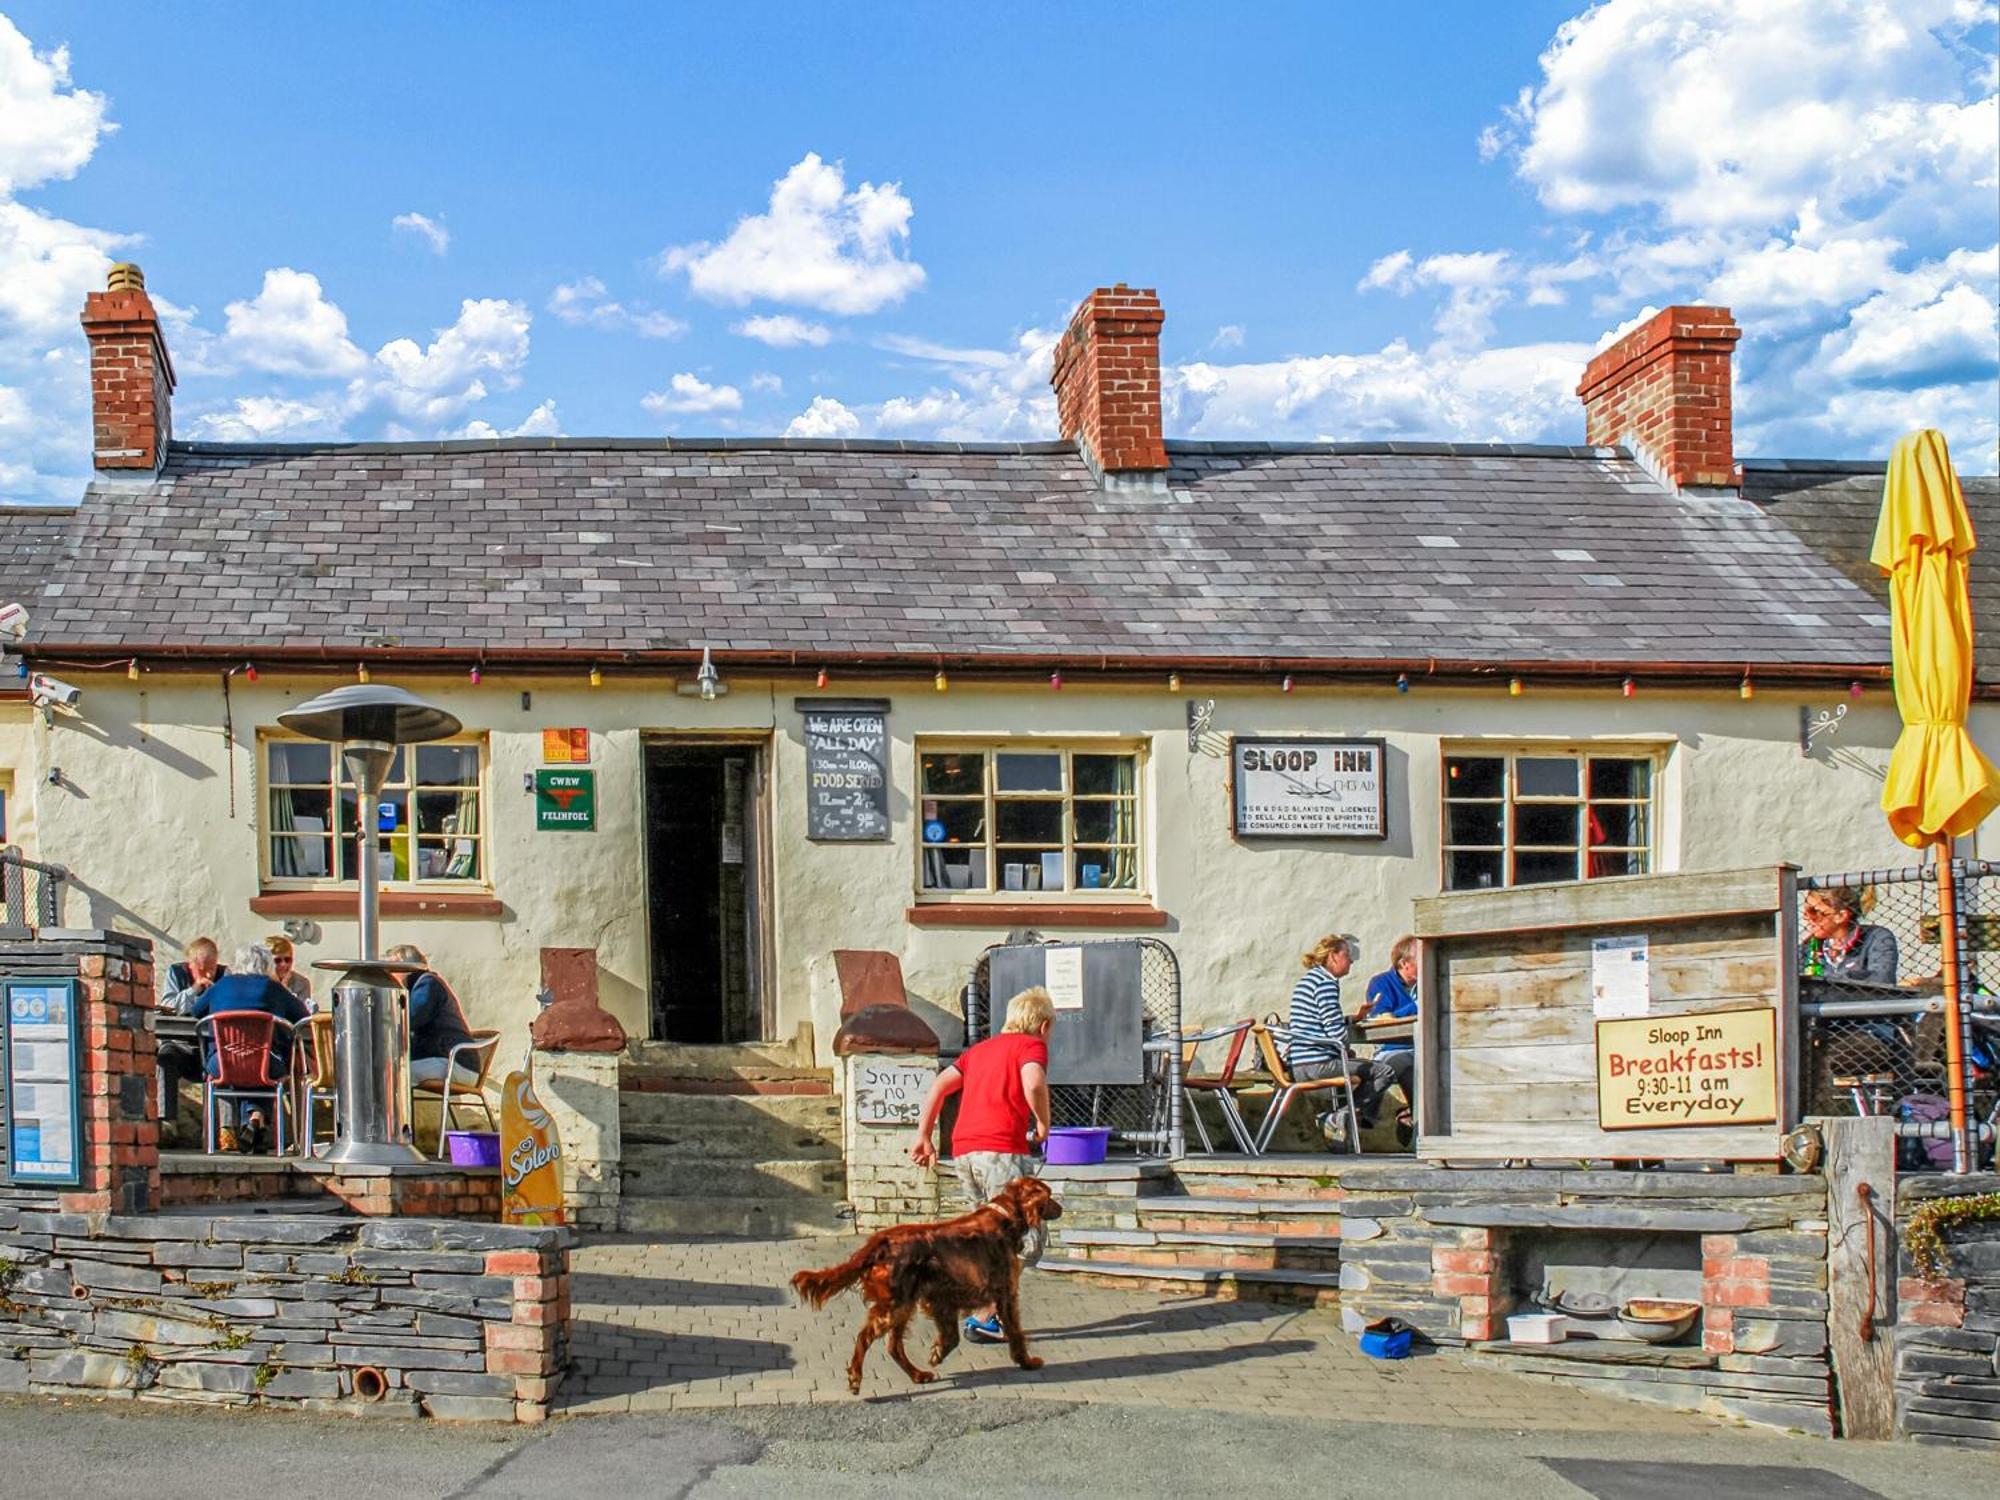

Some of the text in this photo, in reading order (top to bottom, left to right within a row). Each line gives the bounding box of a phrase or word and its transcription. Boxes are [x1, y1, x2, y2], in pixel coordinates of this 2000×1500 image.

[808, 716, 883, 734] We ARE OPEN
[847, 736, 876, 751] DAY
[1243, 750, 1372, 772] SLOOP INN
[549, 776, 580, 786] CWRW
[813, 773, 883, 789] FOOD SERVED
[1327, 822, 1342, 830] THE
[1648, 1025, 1723, 1046] Sloop Inn
[1609, 1042, 1763, 1078] Breakfasts!
[865, 1068, 924, 1089] Sorry
[1637, 1075, 1729, 1097] 9:30-11 am
[884, 1087, 905, 1100] no
[1625, 1094, 1745, 1118] Everyday
[508, 1143, 561, 1186] Solero
